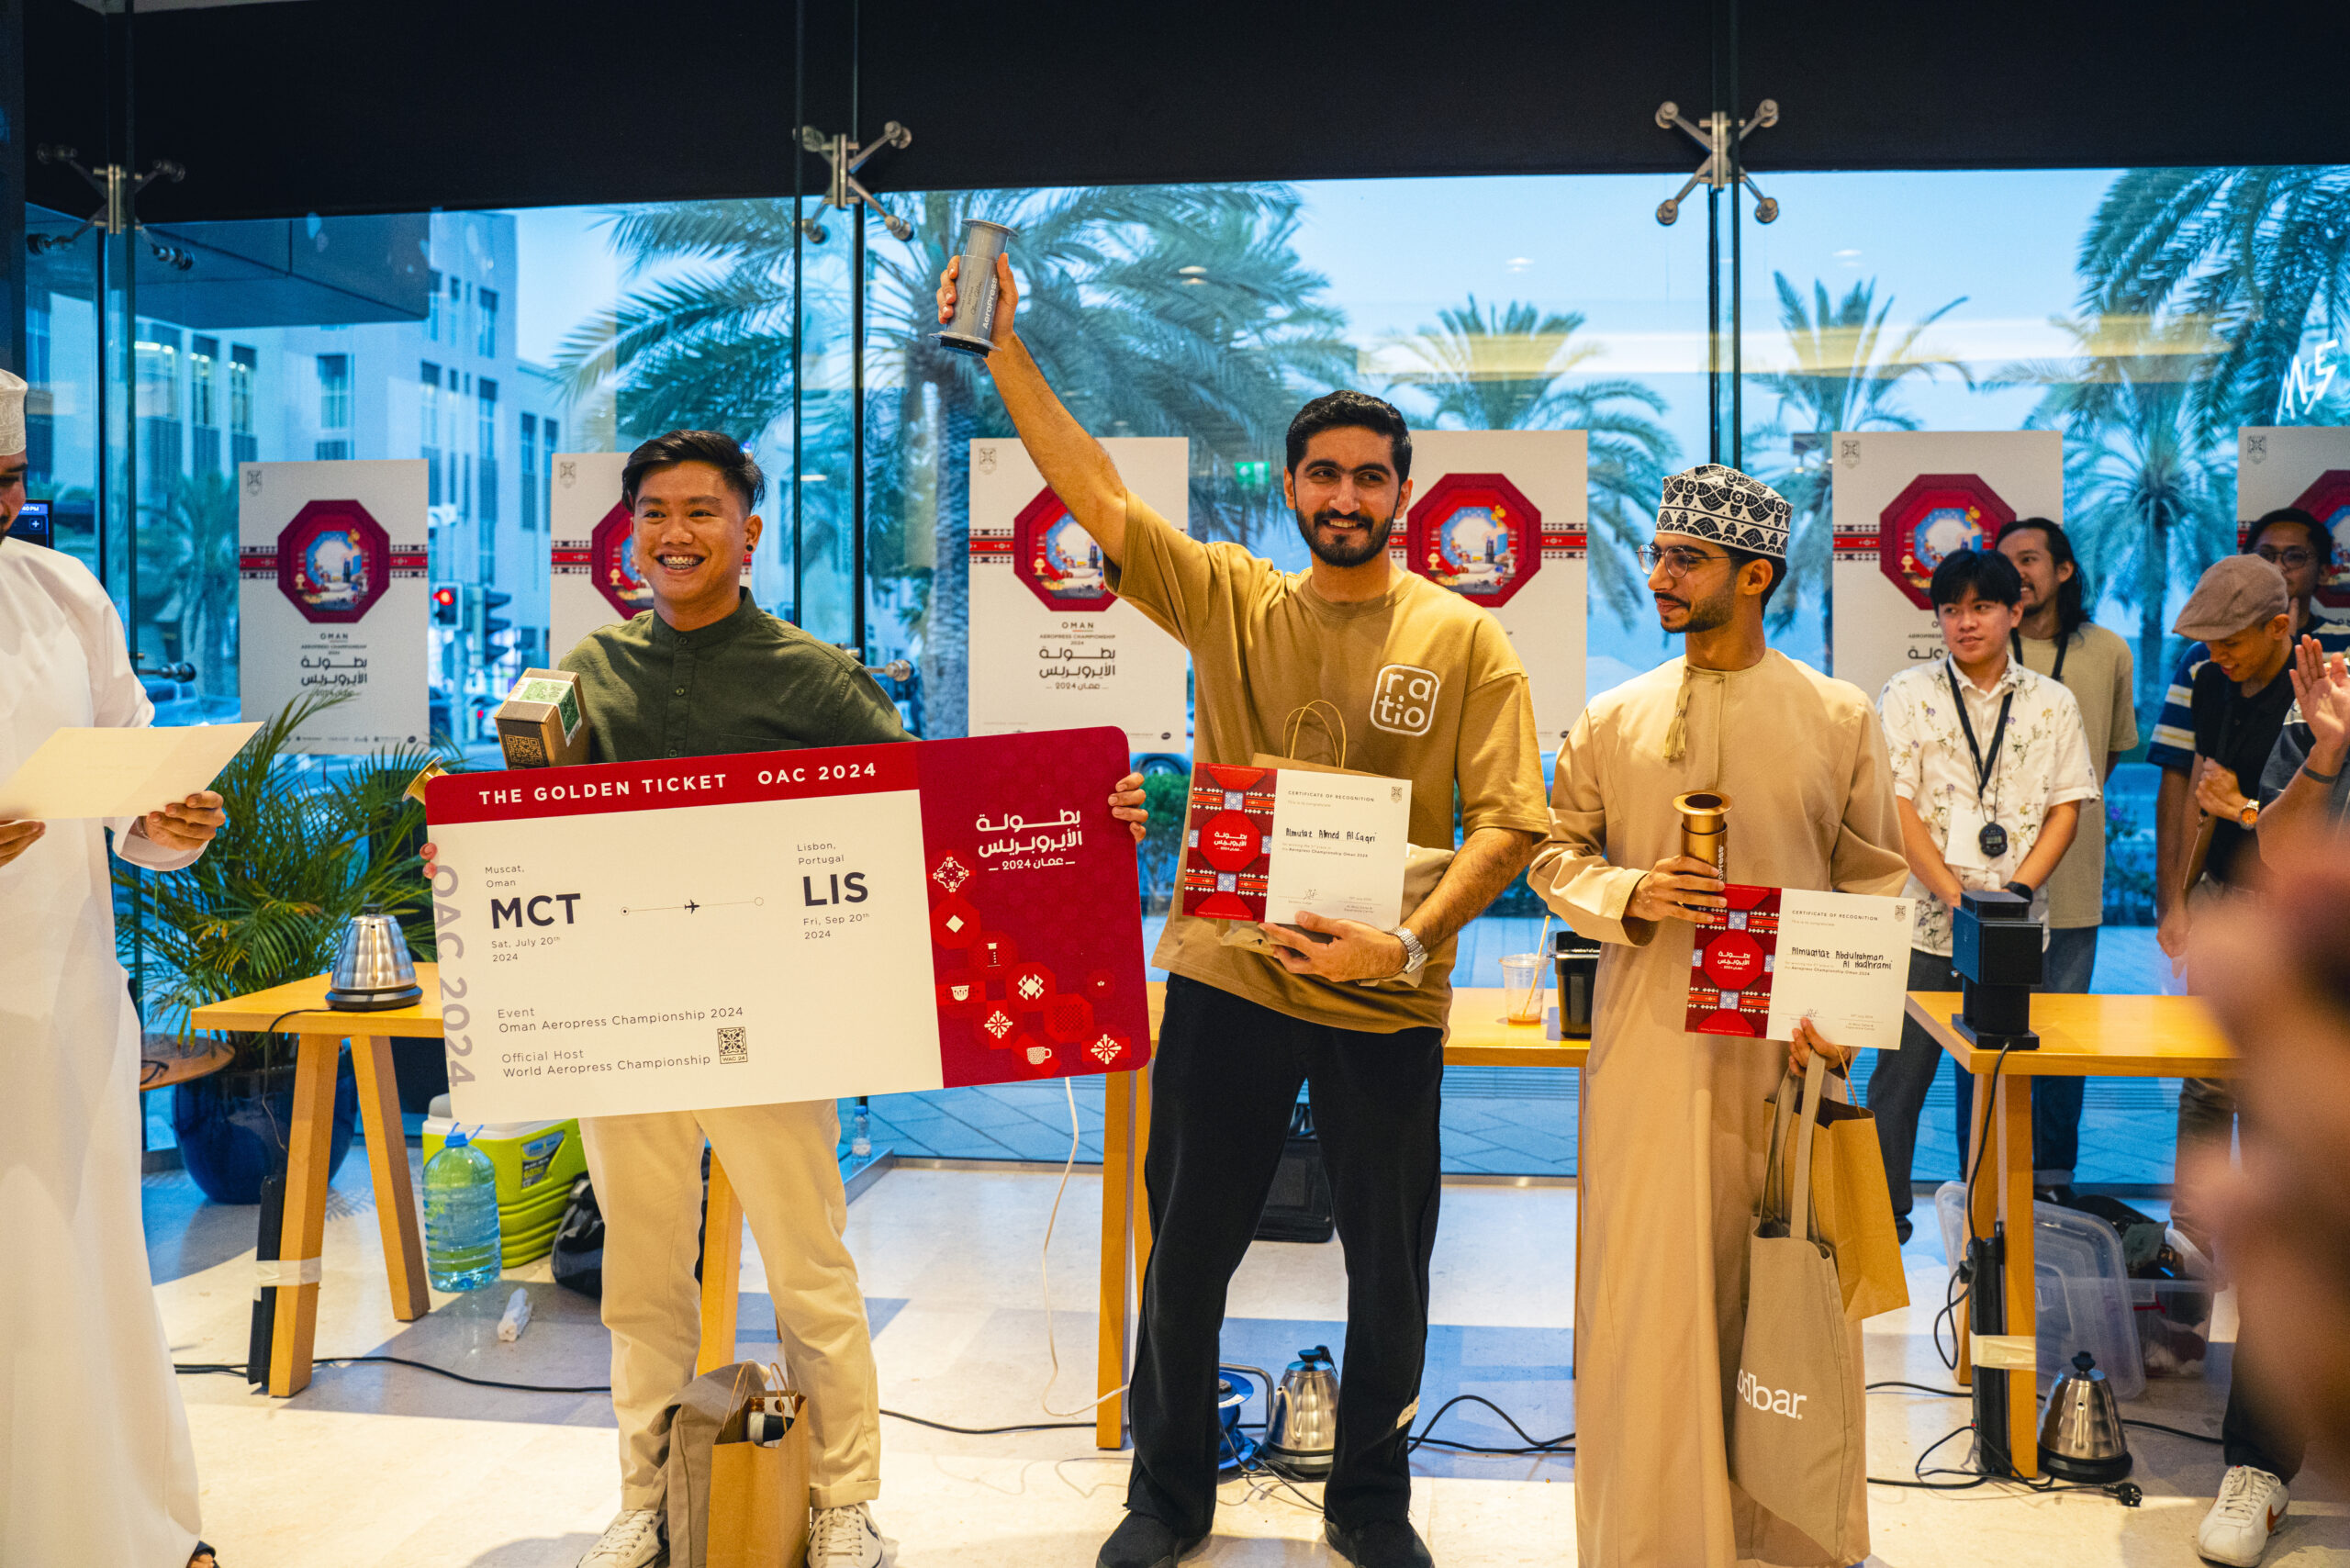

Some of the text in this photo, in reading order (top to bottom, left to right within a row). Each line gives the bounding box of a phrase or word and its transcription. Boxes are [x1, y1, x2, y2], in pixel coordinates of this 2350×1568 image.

[982, 277, 998, 330] AeroPress
[1039, 645, 1115, 662] بطولة
[479, 762, 878, 805] THE GOLDEN TICKET OAC 2024
[1336, 794, 1374, 802] RECOGNITION
[976, 809, 1081, 833] بطولة
[797, 843, 836, 852] Lisbon,
[979, 830, 1083, 857] الأيروبريس
[799, 855, 845, 865] Portugal
[1002, 857, 1063, 870] عمان 2024
[485, 865, 525, 875] Muscat,
[486, 879, 516, 889] Oman
[803, 872, 868, 907] LIS
[490, 892, 581, 929] MCT
[803, 917, 821, 925] Fri,
[826, 916, 845, 924] Sep
[804, 930, 831, 940] 2024
[492, 940, 511, 949] Sat,
[515, 937, 536, 947] July
[492, 953, 518, 962] 2024
[432, 865, 476, 1087] OAC 2024
[498, 1008, 535, 1019] Event
[498, 1006, 744, 1034] Oman Aeropress Championship 2024
[501, 1049, 584, 1063] Official Host
[503, 1054, 711, 1078] World Aeropress Championship
